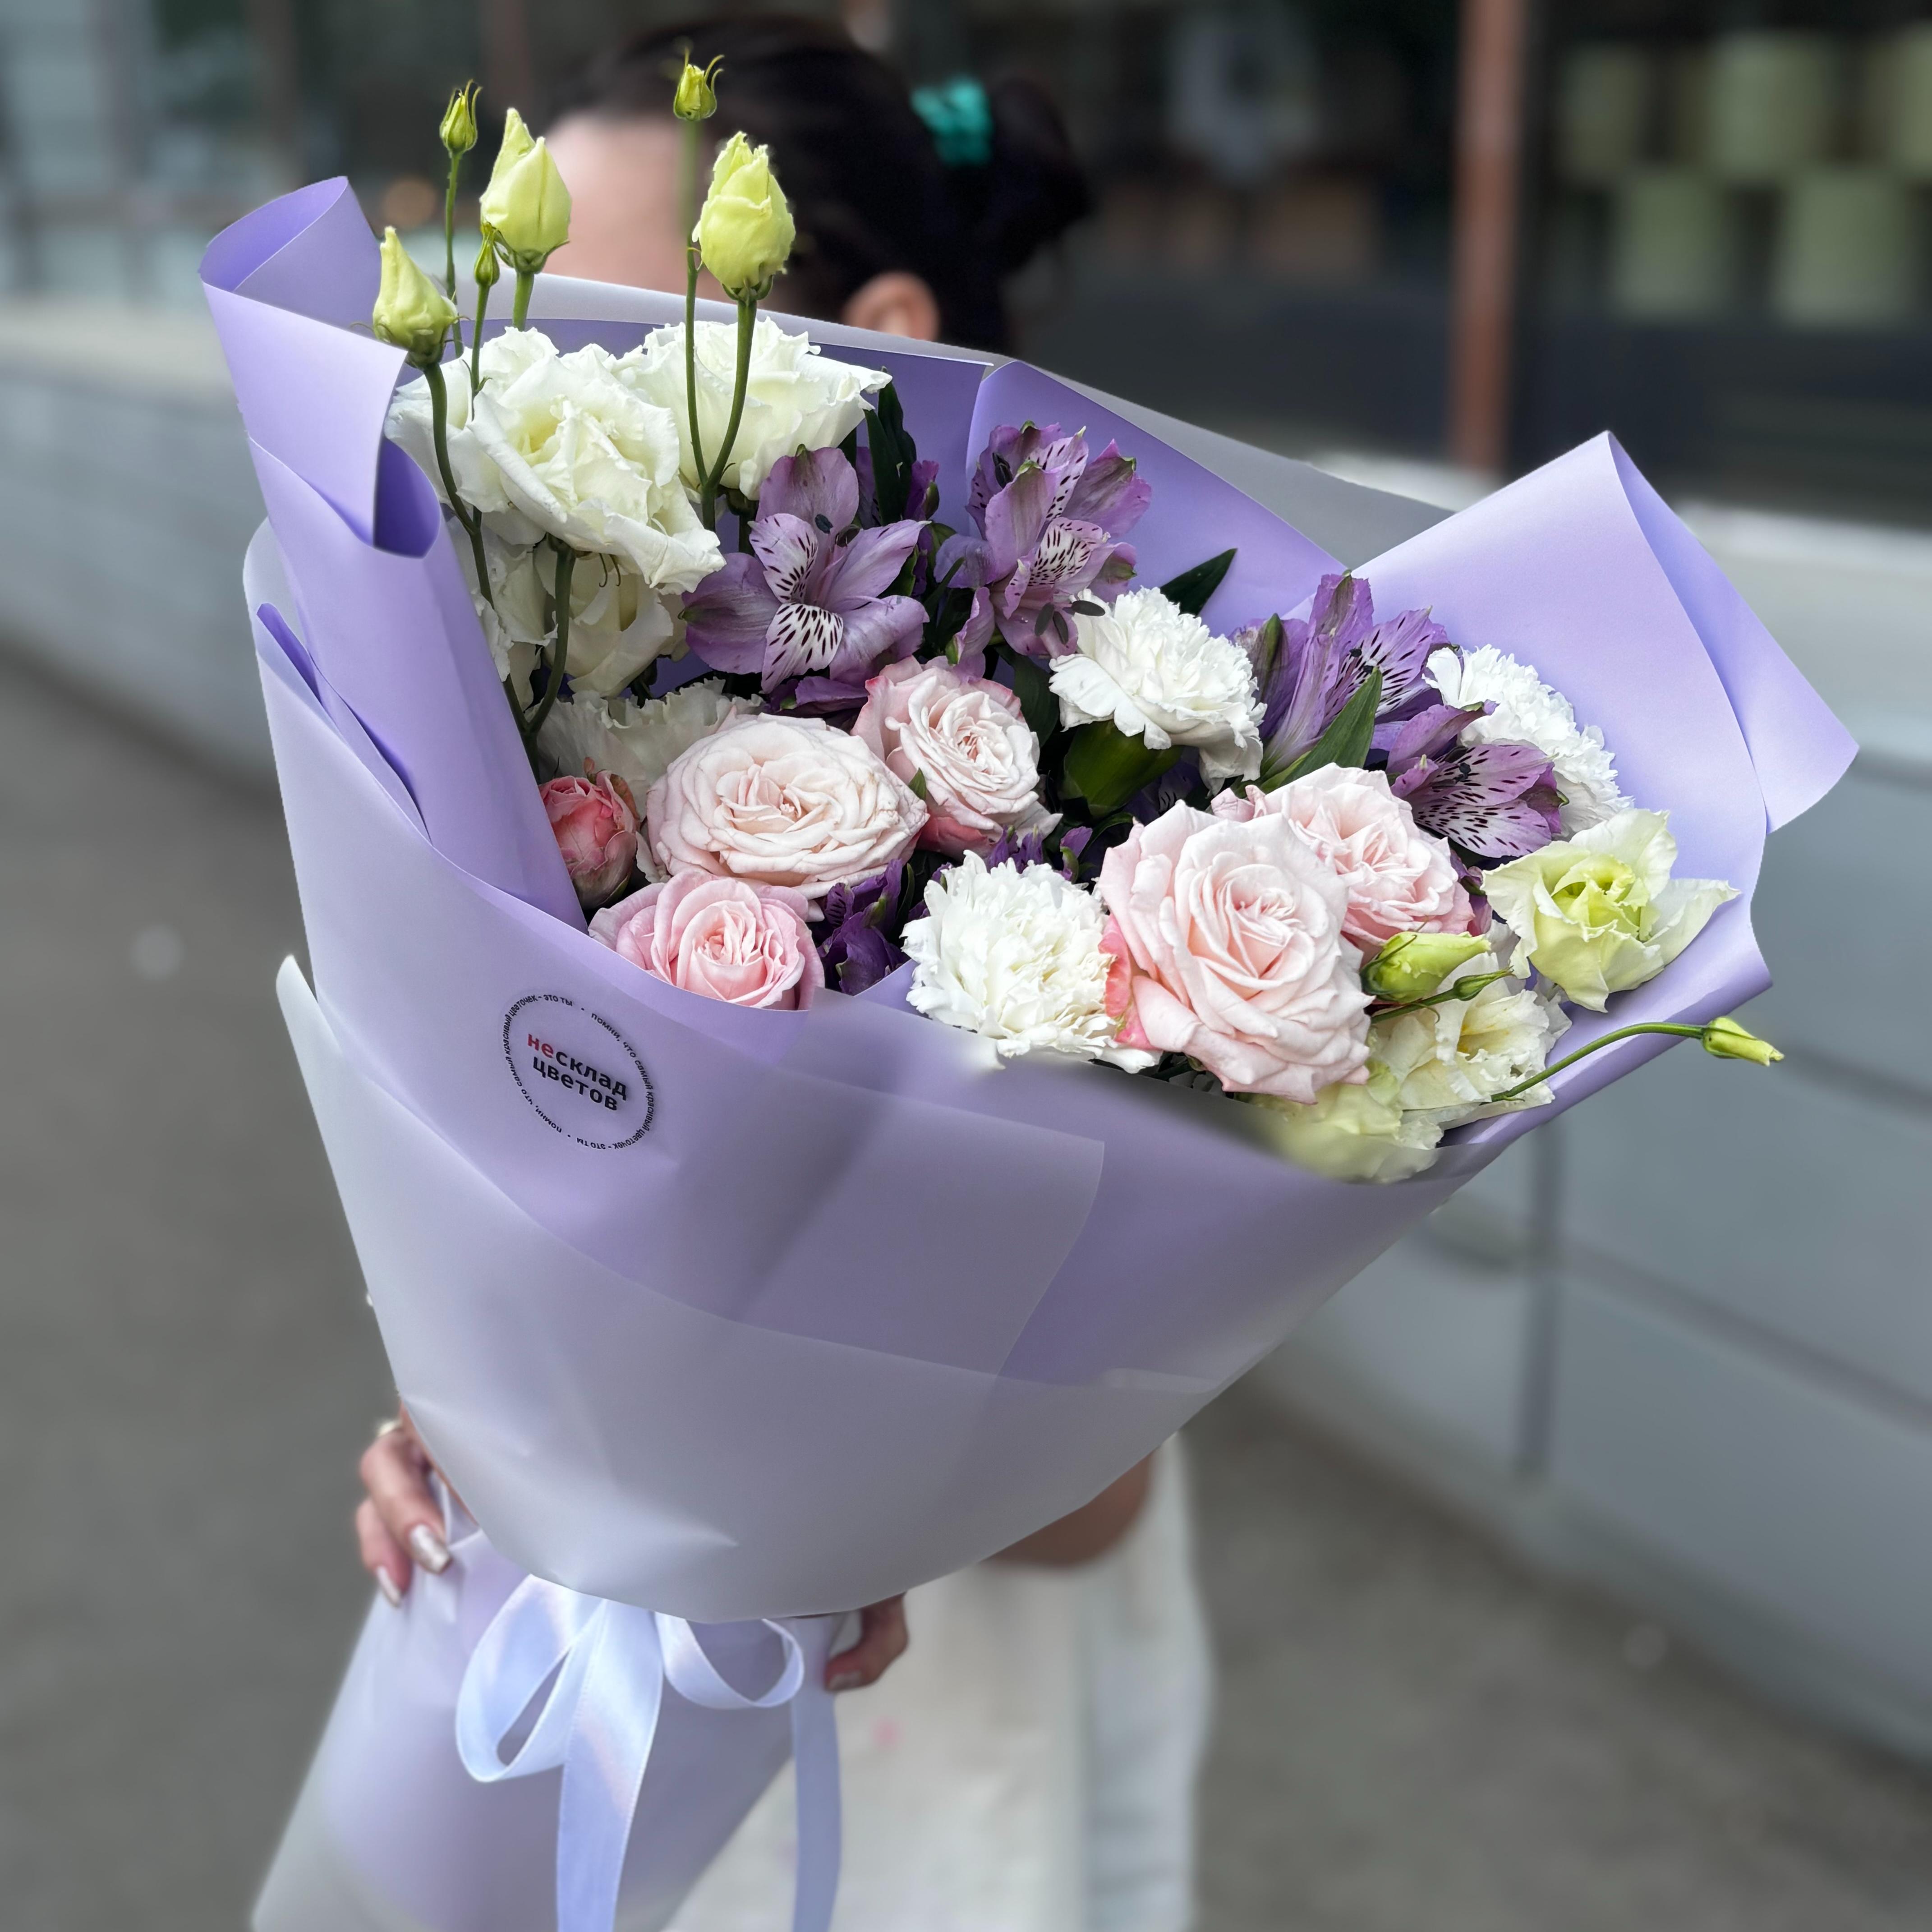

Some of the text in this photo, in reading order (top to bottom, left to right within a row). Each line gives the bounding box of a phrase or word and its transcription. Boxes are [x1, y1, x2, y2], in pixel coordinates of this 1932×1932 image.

[521, 1090, 533, 1104] что
[561, 997, 573, 1007] ты
[623, 1042, 635, 1058] что
[533, 1056, 618, 1111] цветов
[577, 1137, 589, 1147] ты
